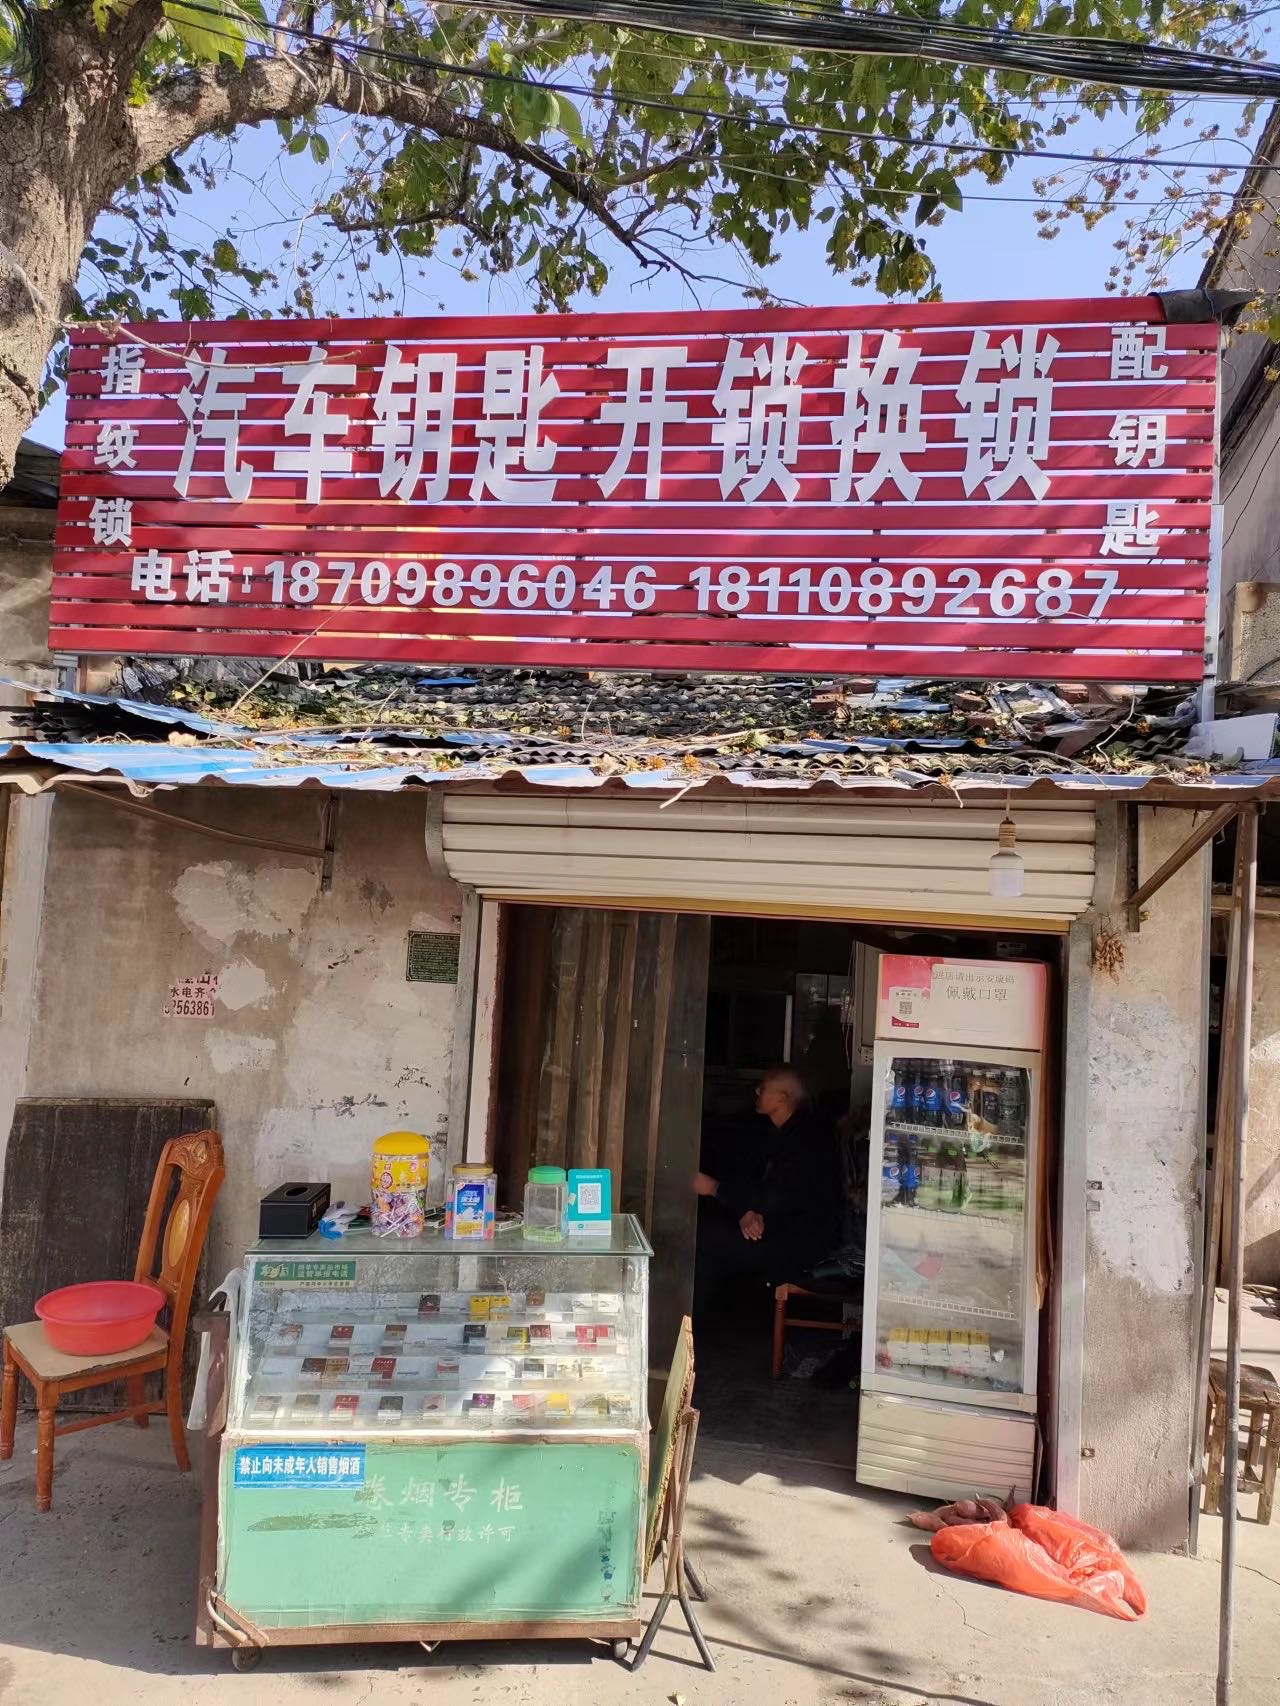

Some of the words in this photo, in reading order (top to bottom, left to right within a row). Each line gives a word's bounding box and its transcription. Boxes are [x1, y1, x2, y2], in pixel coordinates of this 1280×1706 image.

[173, 327, 1060, 505] 汽车钥匙开锁换锁
[1100, 327, 1168, 556] 配钥匙
[89, 347, 146, 547] 指纹锁
[690, 565, 1120, 619] 18110892687
[170, 987, 216, 999] 水电齐
[945, 984, 1008, 1002] 佩戴口罩
[239, 1456, 360, 1475] 禁止向未成年人销售烟酒
